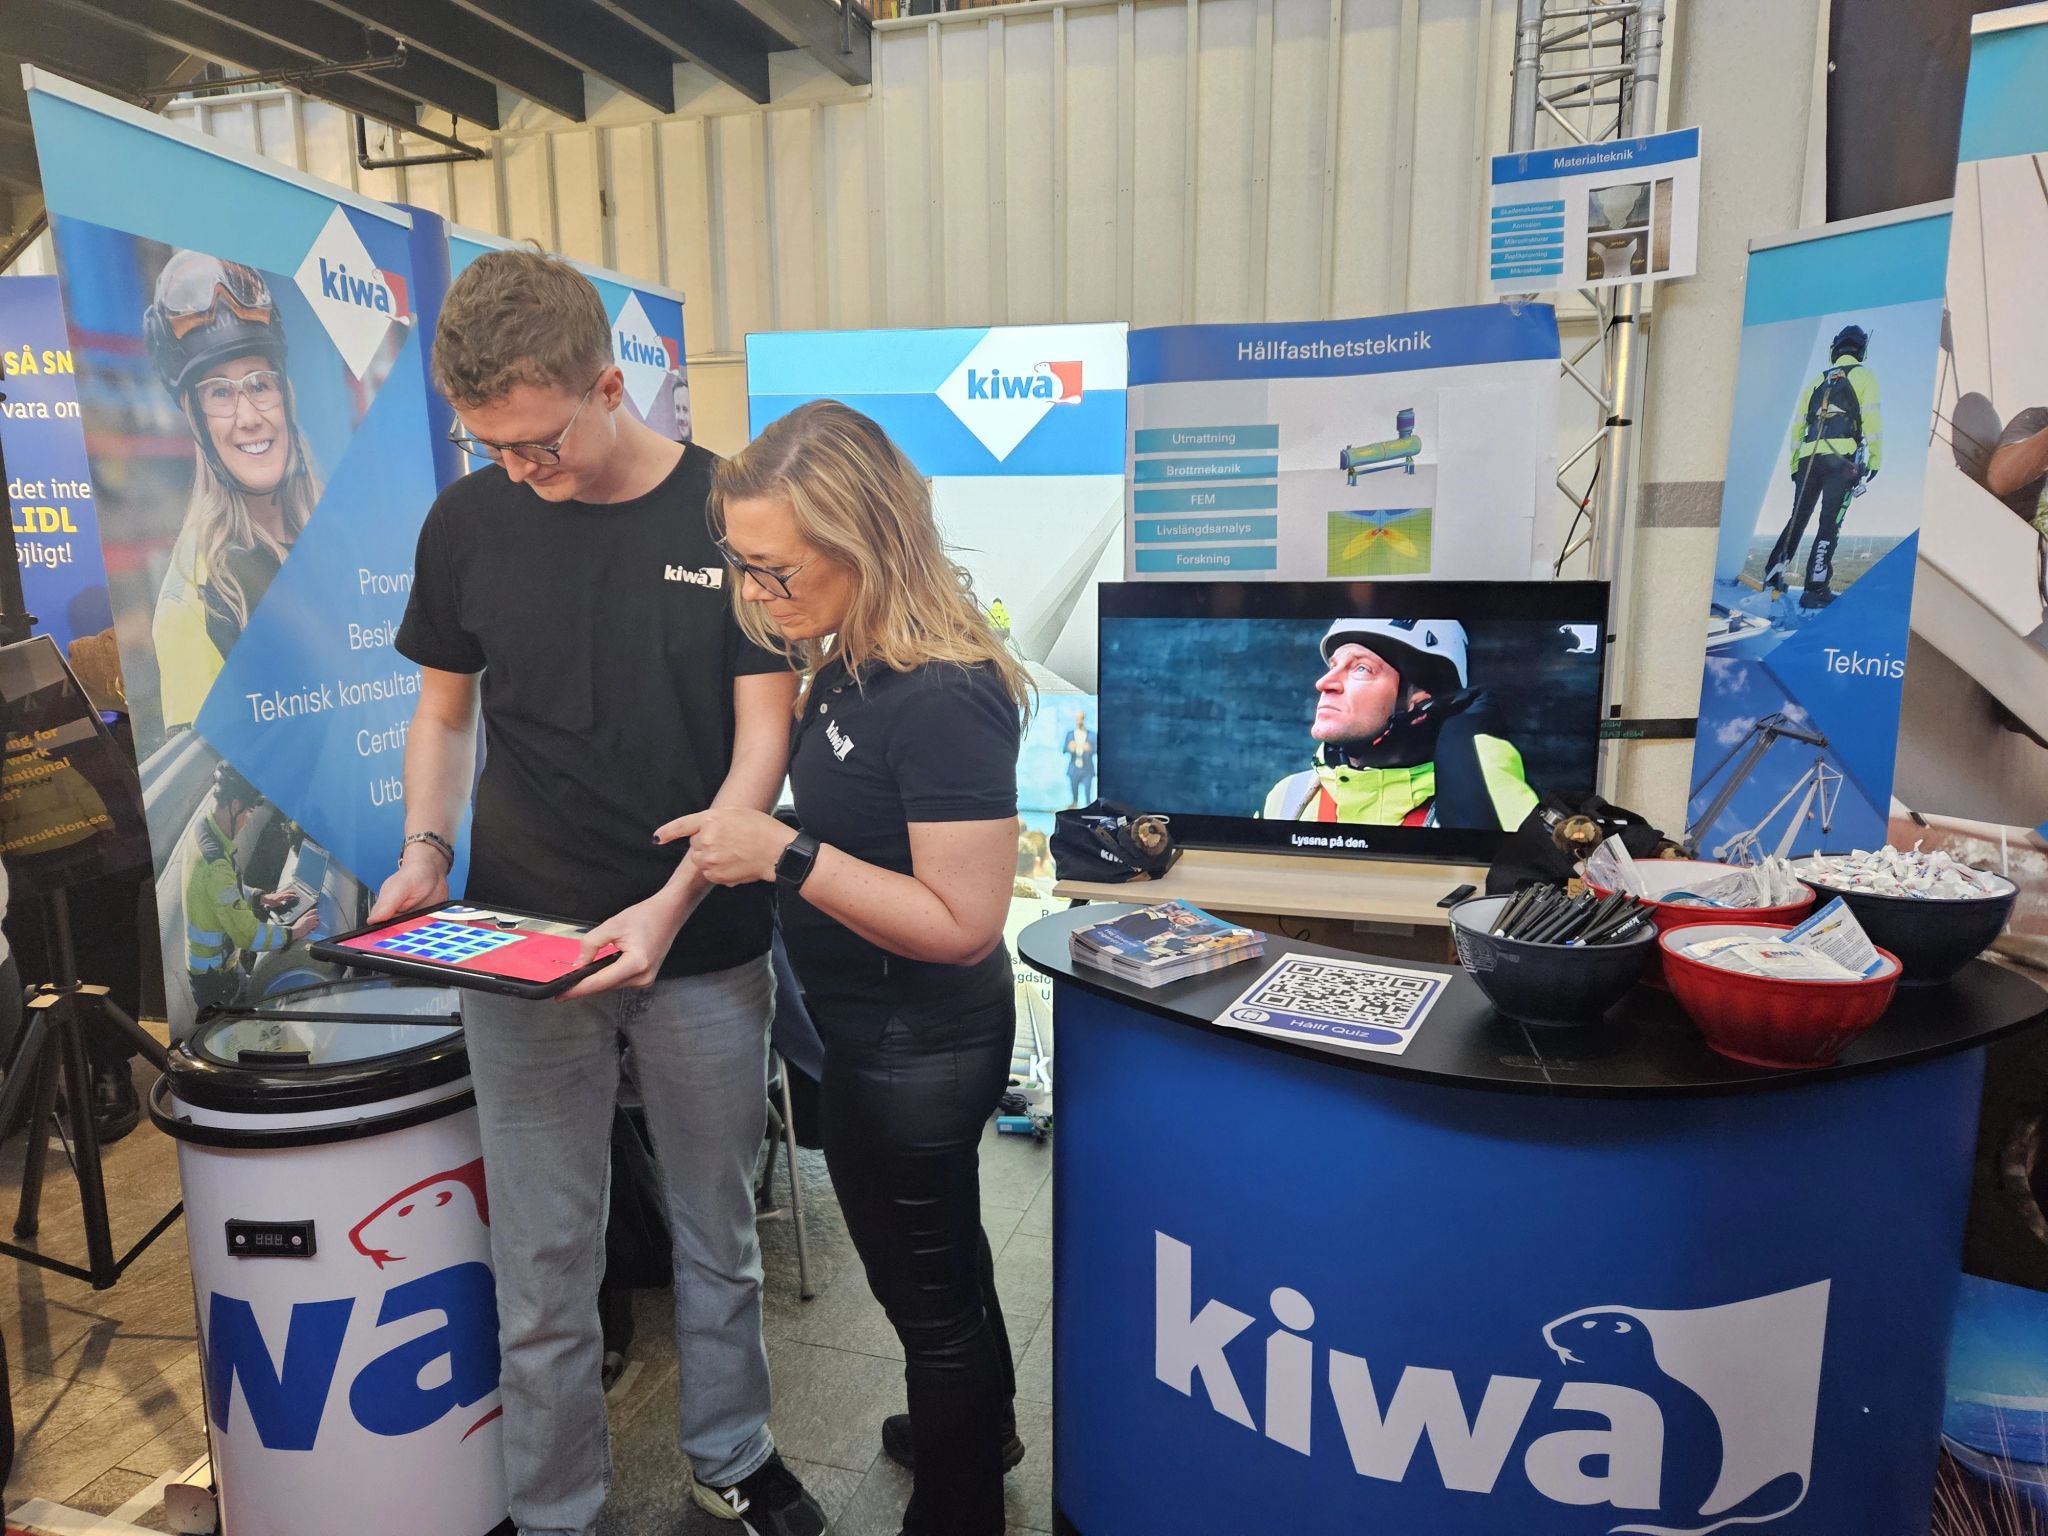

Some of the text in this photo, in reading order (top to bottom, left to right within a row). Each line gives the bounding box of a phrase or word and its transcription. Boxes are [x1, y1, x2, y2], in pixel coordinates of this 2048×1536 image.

[1554, 150, 1633, 169] Materialteknik
[319, 257, 390, 314] kiwa
[618, 330, 666, 369] kiwa
[1238, 330, 1432, 362] Hållfasthetsteknik
[4, 344, 39, 376] SÅ
[967, 368, 1053, 400] kiwa
[1, 401, 50, 419] vara
[1172, 431, 1236, 447] Utmattning
[1166, 463, 1241, 477] Brottmekanik
[8, 477, 92, 499] det inte
[1190, 494, 1216, 506] FEM
[1156, 521, 1251, 538] Livslängdsanalys
[1176, 553, 1231, 566] Forskning
[664, 564, 708, 586] kiwa
[1823, 647, 1905, 679] Teknis
[245, 683, 335, 723] Teknisk
[1291, 833, 1369, 849] Lyssna på den.
[1331, 1026, 1370, 1039] Quiz
[1155, 1229, 1661, 1510] kiwa
